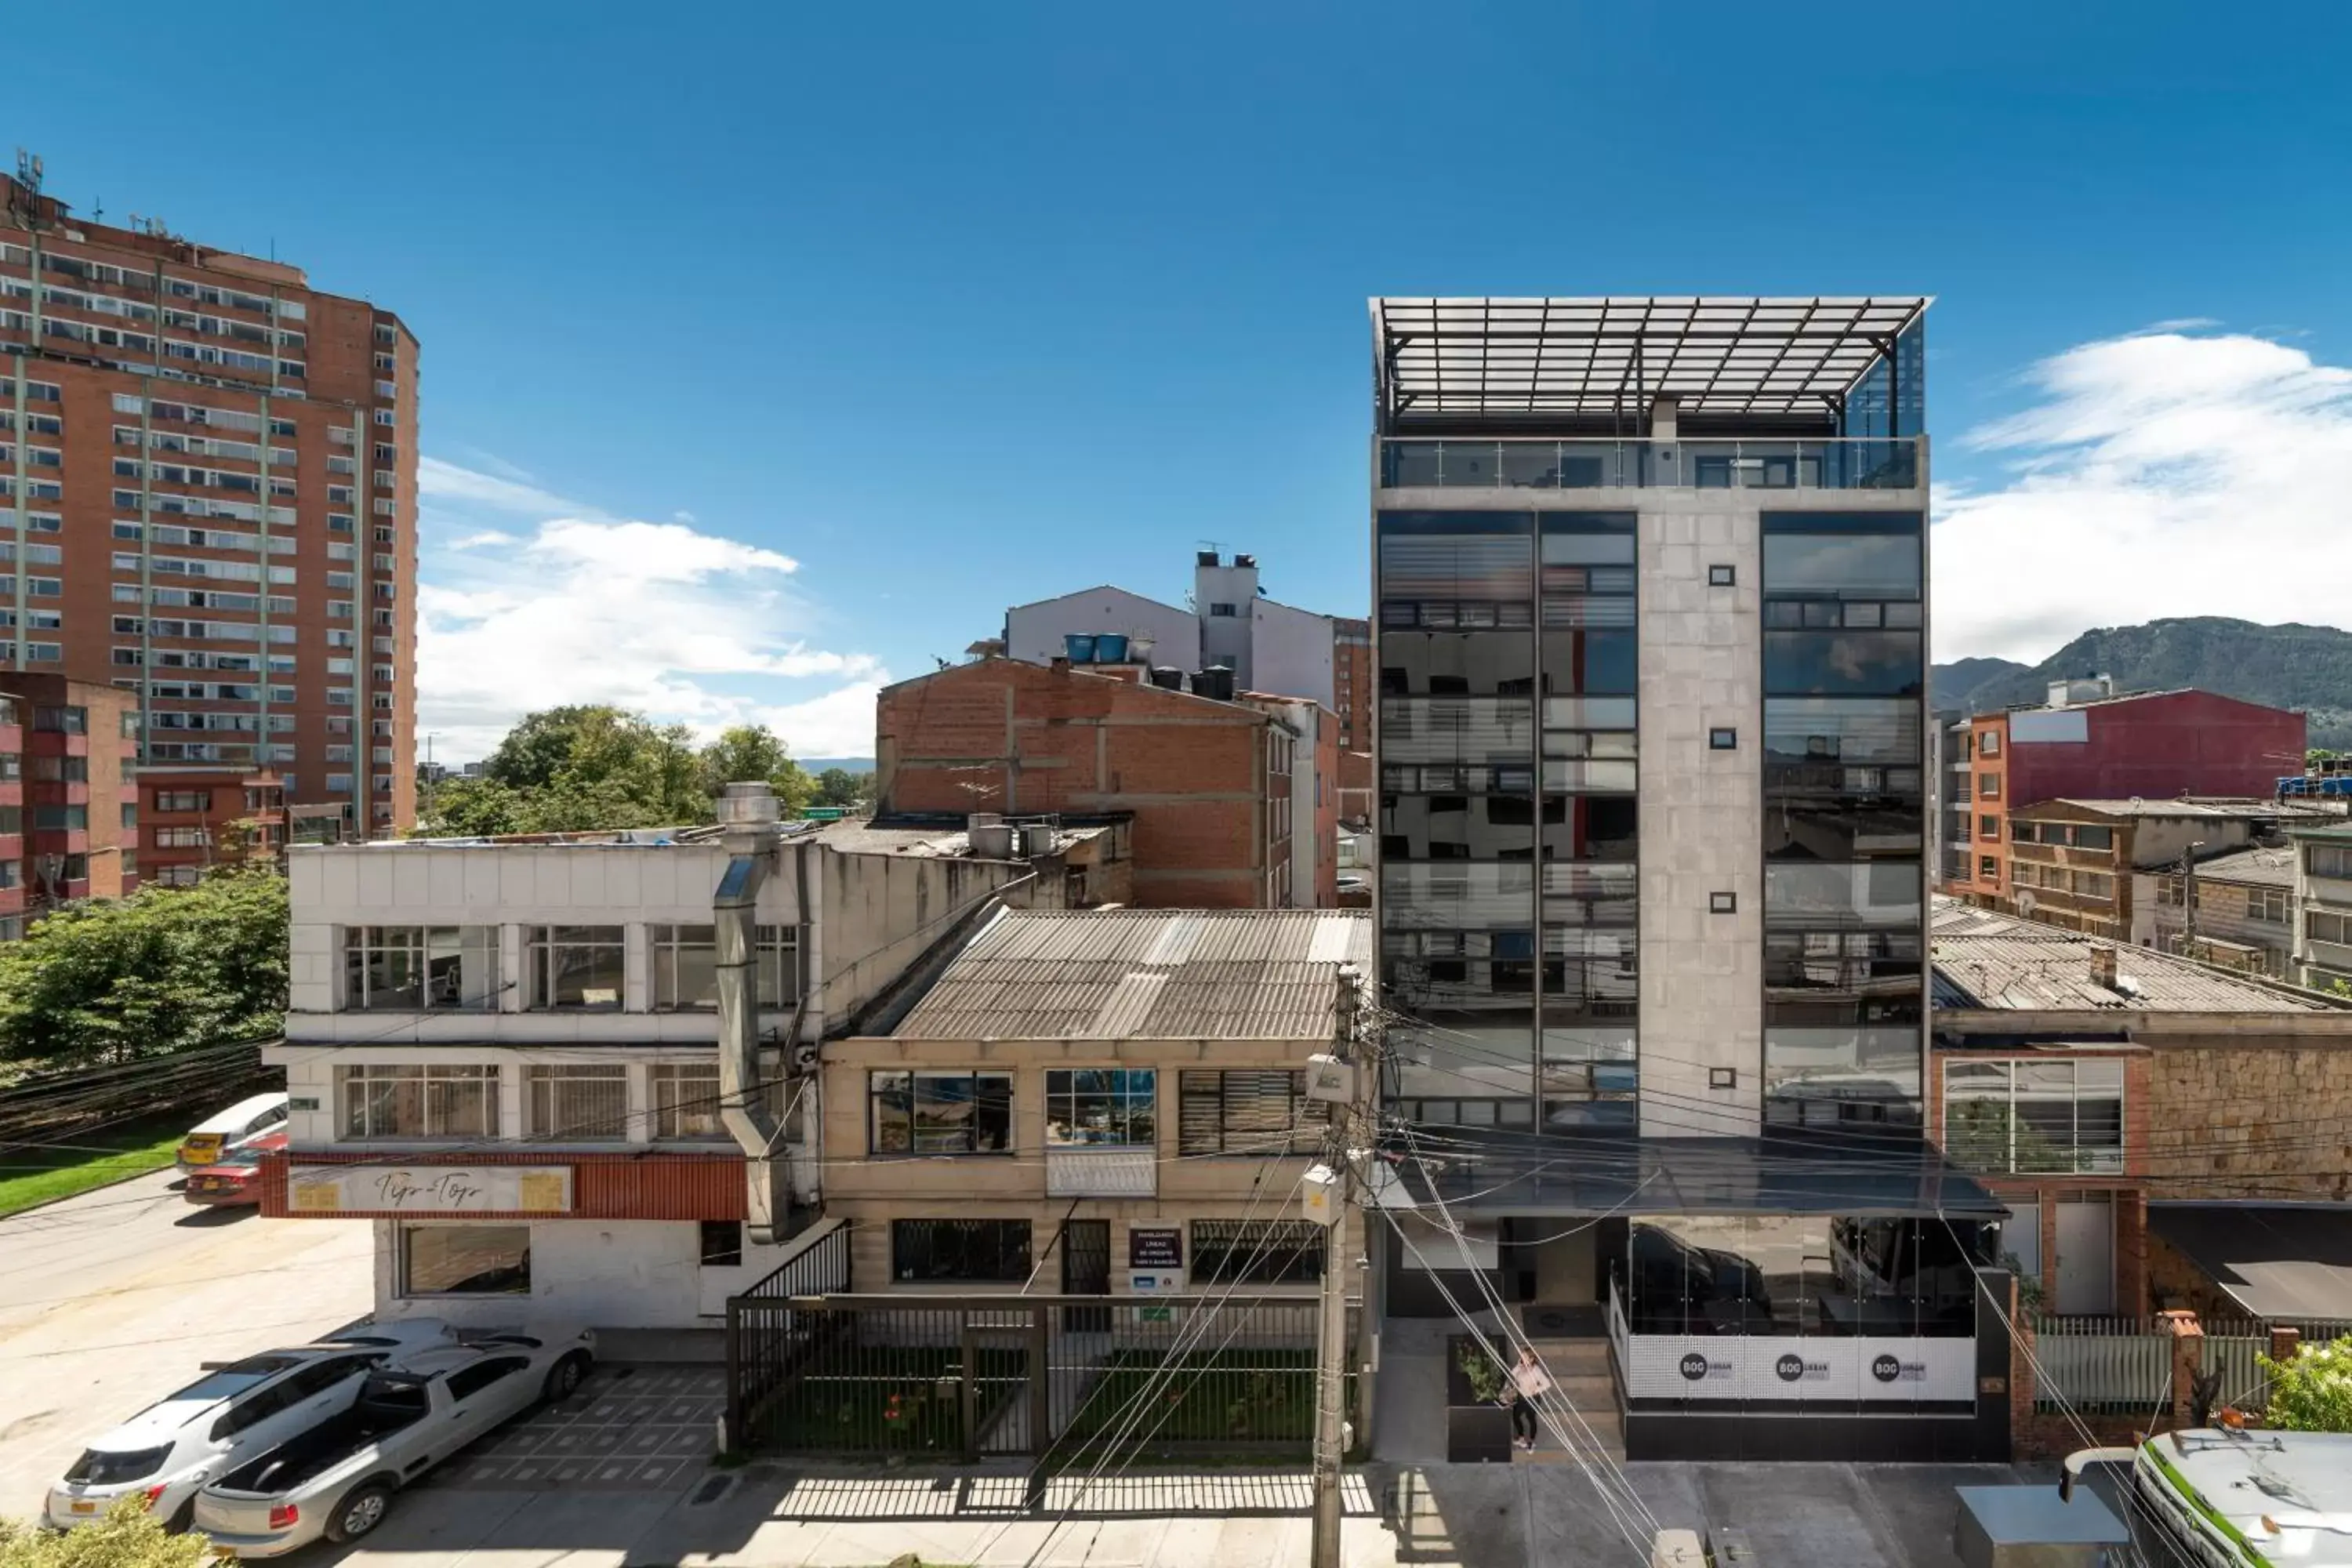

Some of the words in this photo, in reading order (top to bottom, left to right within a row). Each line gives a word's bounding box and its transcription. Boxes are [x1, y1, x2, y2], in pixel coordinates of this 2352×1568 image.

[1683, 1362, 1704, 1373] BOG
[1779, 1363, 1801, 1374] BOG
[1876, 1363, 1897, 1374] BOG
